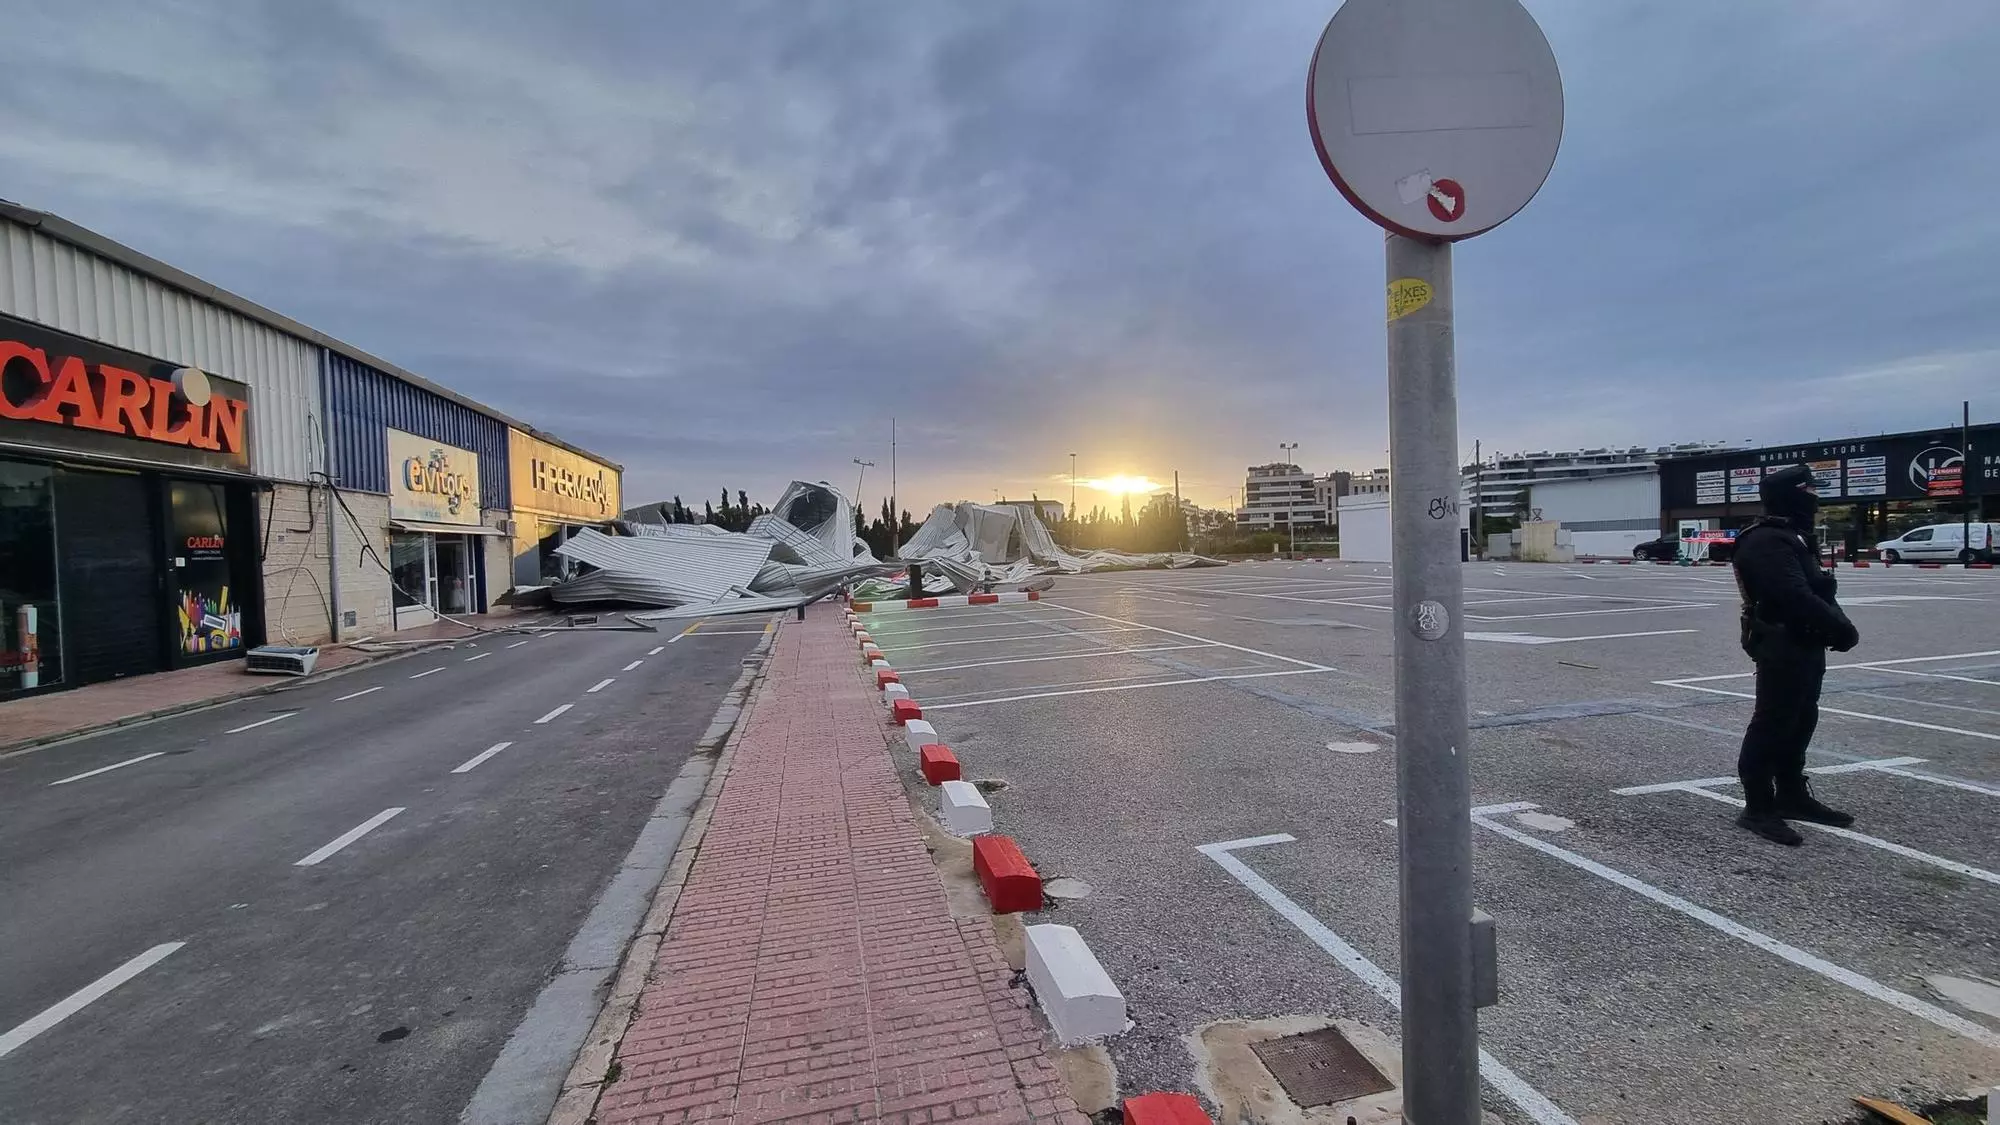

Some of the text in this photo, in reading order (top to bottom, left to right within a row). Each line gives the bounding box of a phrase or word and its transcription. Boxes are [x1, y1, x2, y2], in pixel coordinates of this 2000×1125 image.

[1759, 444, 1866, 462] MARINE STORE
[532, 458, 612, 512] HIPERMENAJE
